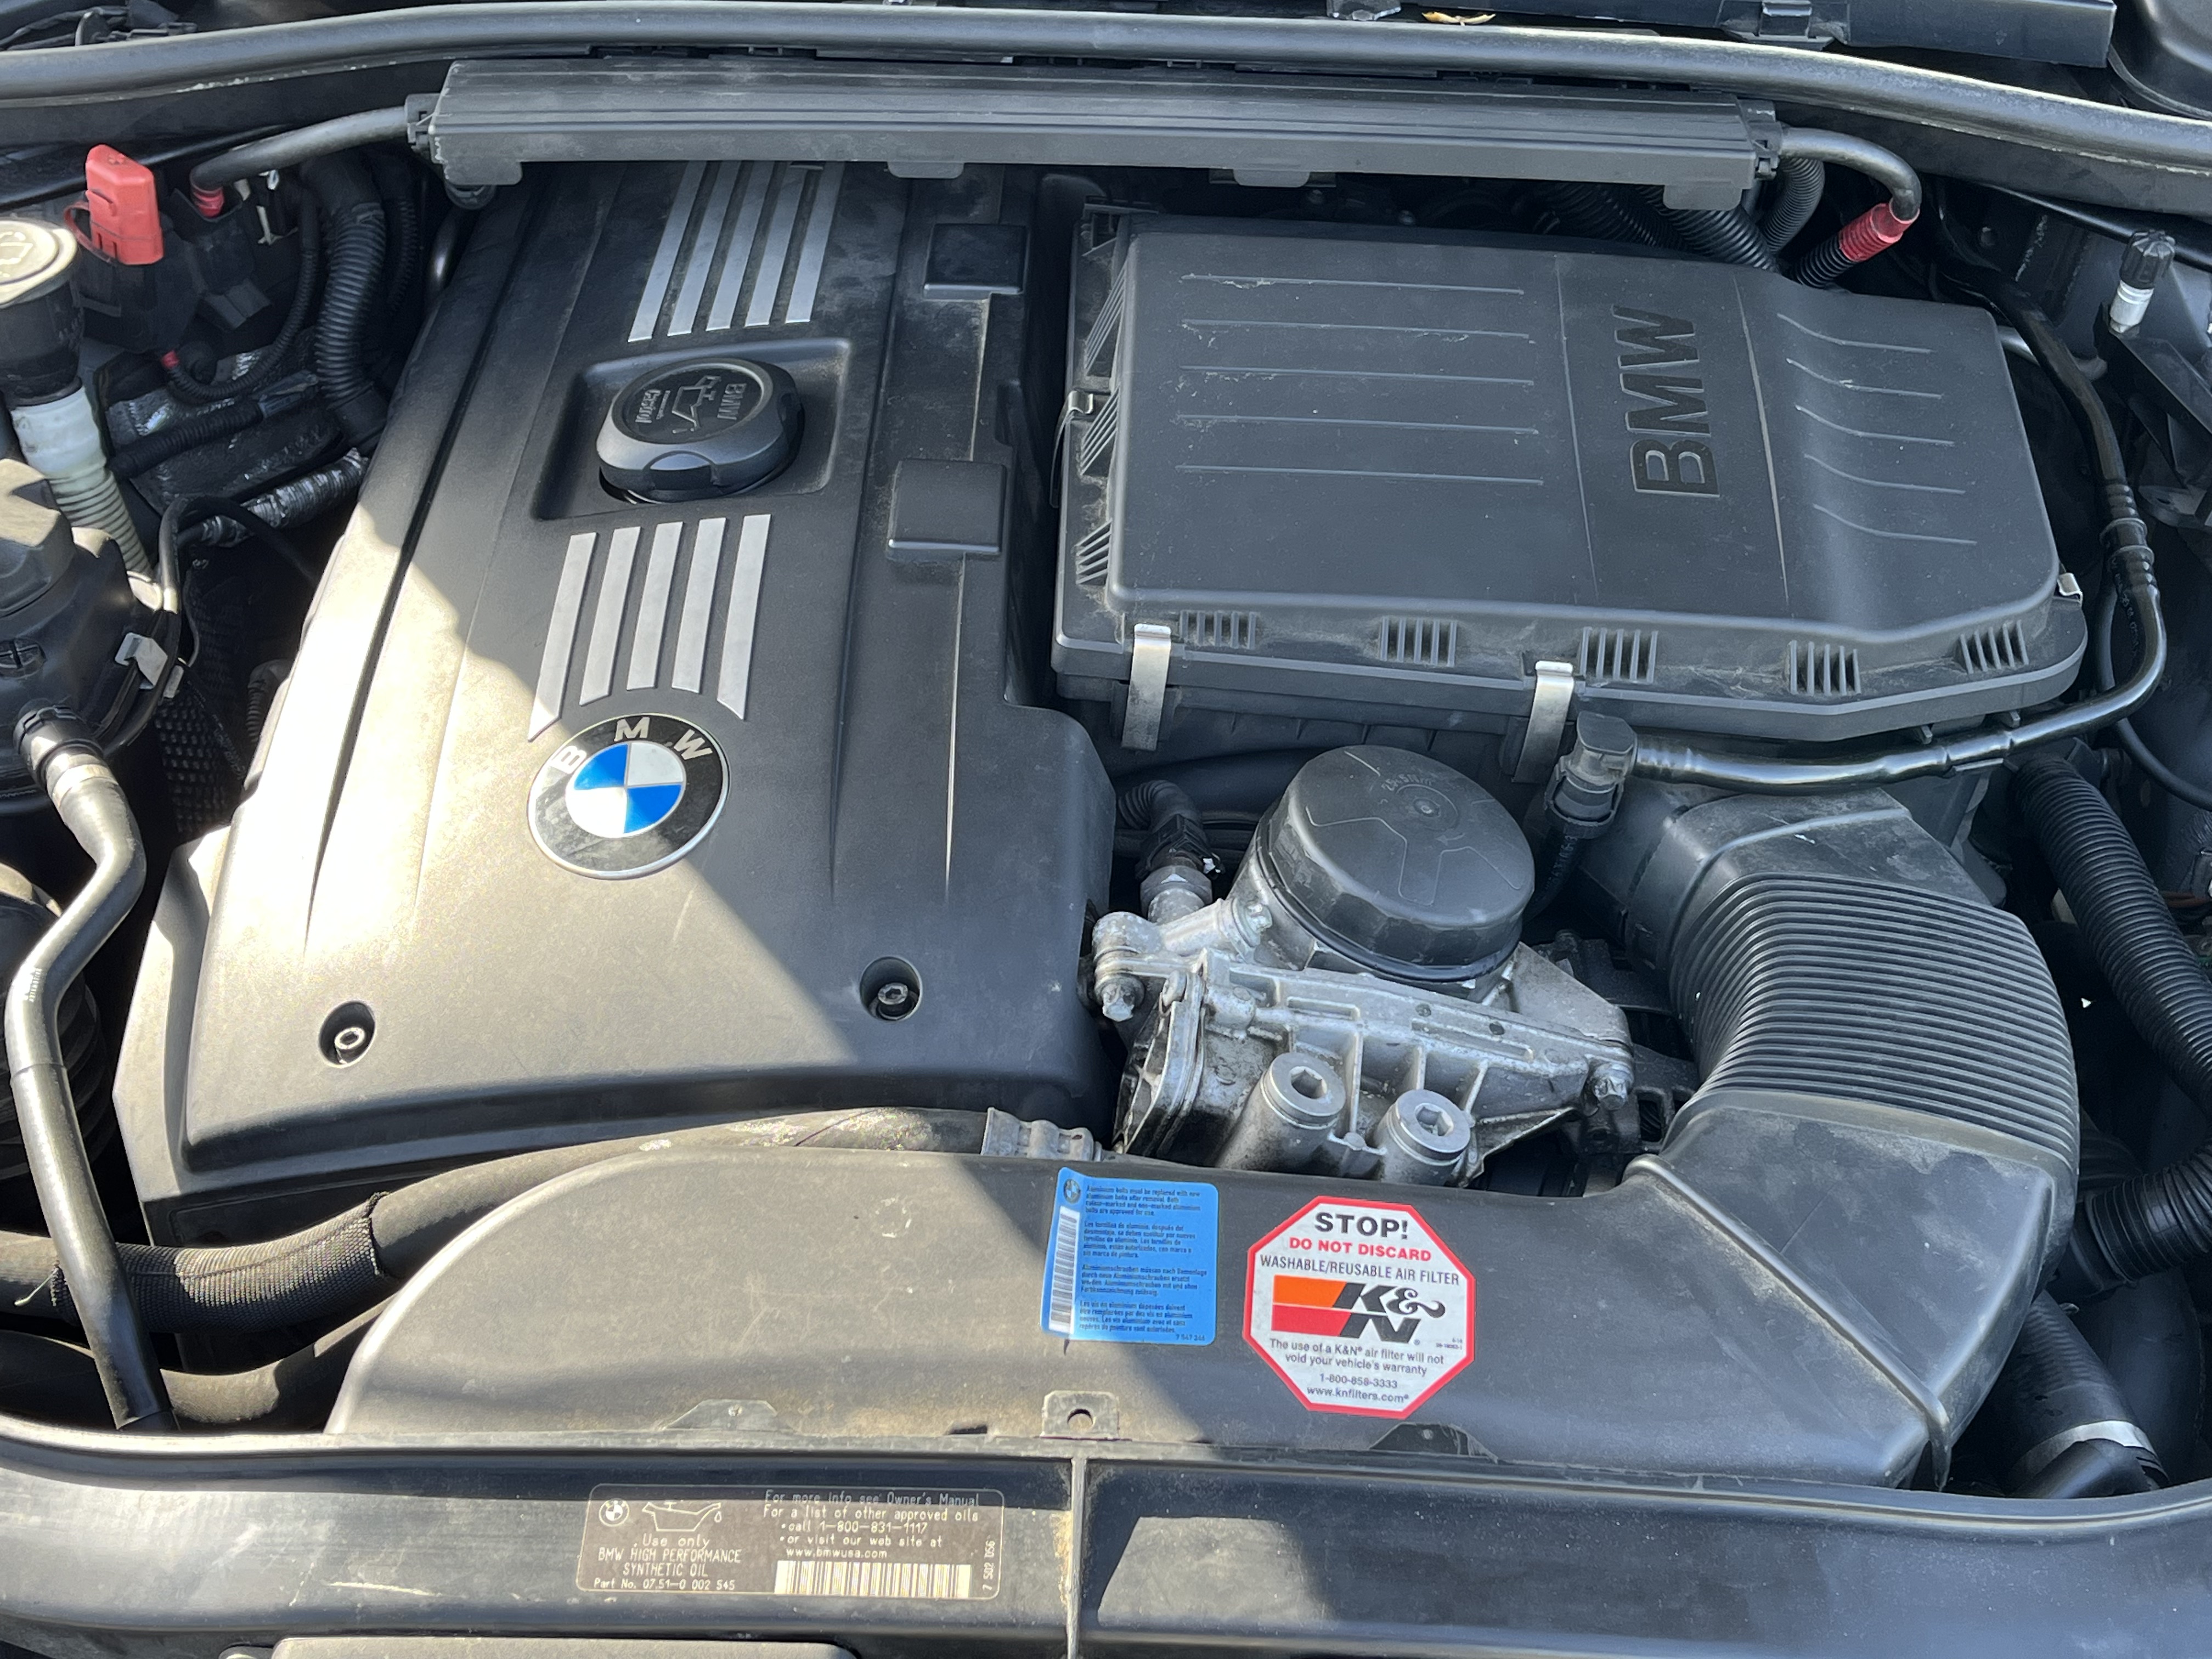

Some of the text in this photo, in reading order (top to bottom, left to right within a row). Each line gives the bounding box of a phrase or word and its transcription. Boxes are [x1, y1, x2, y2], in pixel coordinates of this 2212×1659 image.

[717, 383, 747, 420] BMW
[1611, 304, 1720, 498] BMW
[549, 716, 713, 774] BMW
[1315, 1211, 1408, 1239] STOP!
[1290, 1237, 1431, 1261] DO NOT DISCARD
[1260, 1254, 1459, 1285] WASHABLE/REUSABLE AIR FILTER
[1270, 1338, 1288, 1349] The
[1291, 1341, 1310, 1351] use
[1313, 1342, 1323, 1352] of
[1365, 1348, 1378, 1357] air
[1381, 1348, 1403, 1361] filter
[1407, 1349, 1424, 1362] will
[1427, 1352, 1444, 1364] not
[1285, 1353, 1427, 1377] void your vehicle's warranty
[765, 1489, 784, 1503] For
[792, 1494, 821, 1504] more
[860, 1494, 878, 1504] see
[887, 1491, 932, 1505] Owner's
[939, 1493, 979, 1507] Manual
[763, 1504, 784, 1518] For
[791, 1509, 798, 1518] a
[805, 1505, 826, 1519] list
[834, 1506, 848, 1519] of
[855, 1509, 887, 1520] other
[894, 1510, 948, 1523] approved
[642, 1533, 710, 1549] Use only
[843, 1537, 861, 1546] our
[870, 1536, 891, 1547] web
[899, 1537, 922, 1547] site
[930, 1536, 942, 1547] at
[598, 1547, 742, 1562] BMW HIGH PERFORMANCE
[786, 1547, 887, 1559] www.bmwusa.com
[623, 1562, 708, 1576] SYNTHETIC OIL
[594, 1577, 615, 1588] Part
[621, 1578, 637, 1589] No.
[692, 1579, 711, 1590] 002
[716, 1579, 736, 1590] 545
